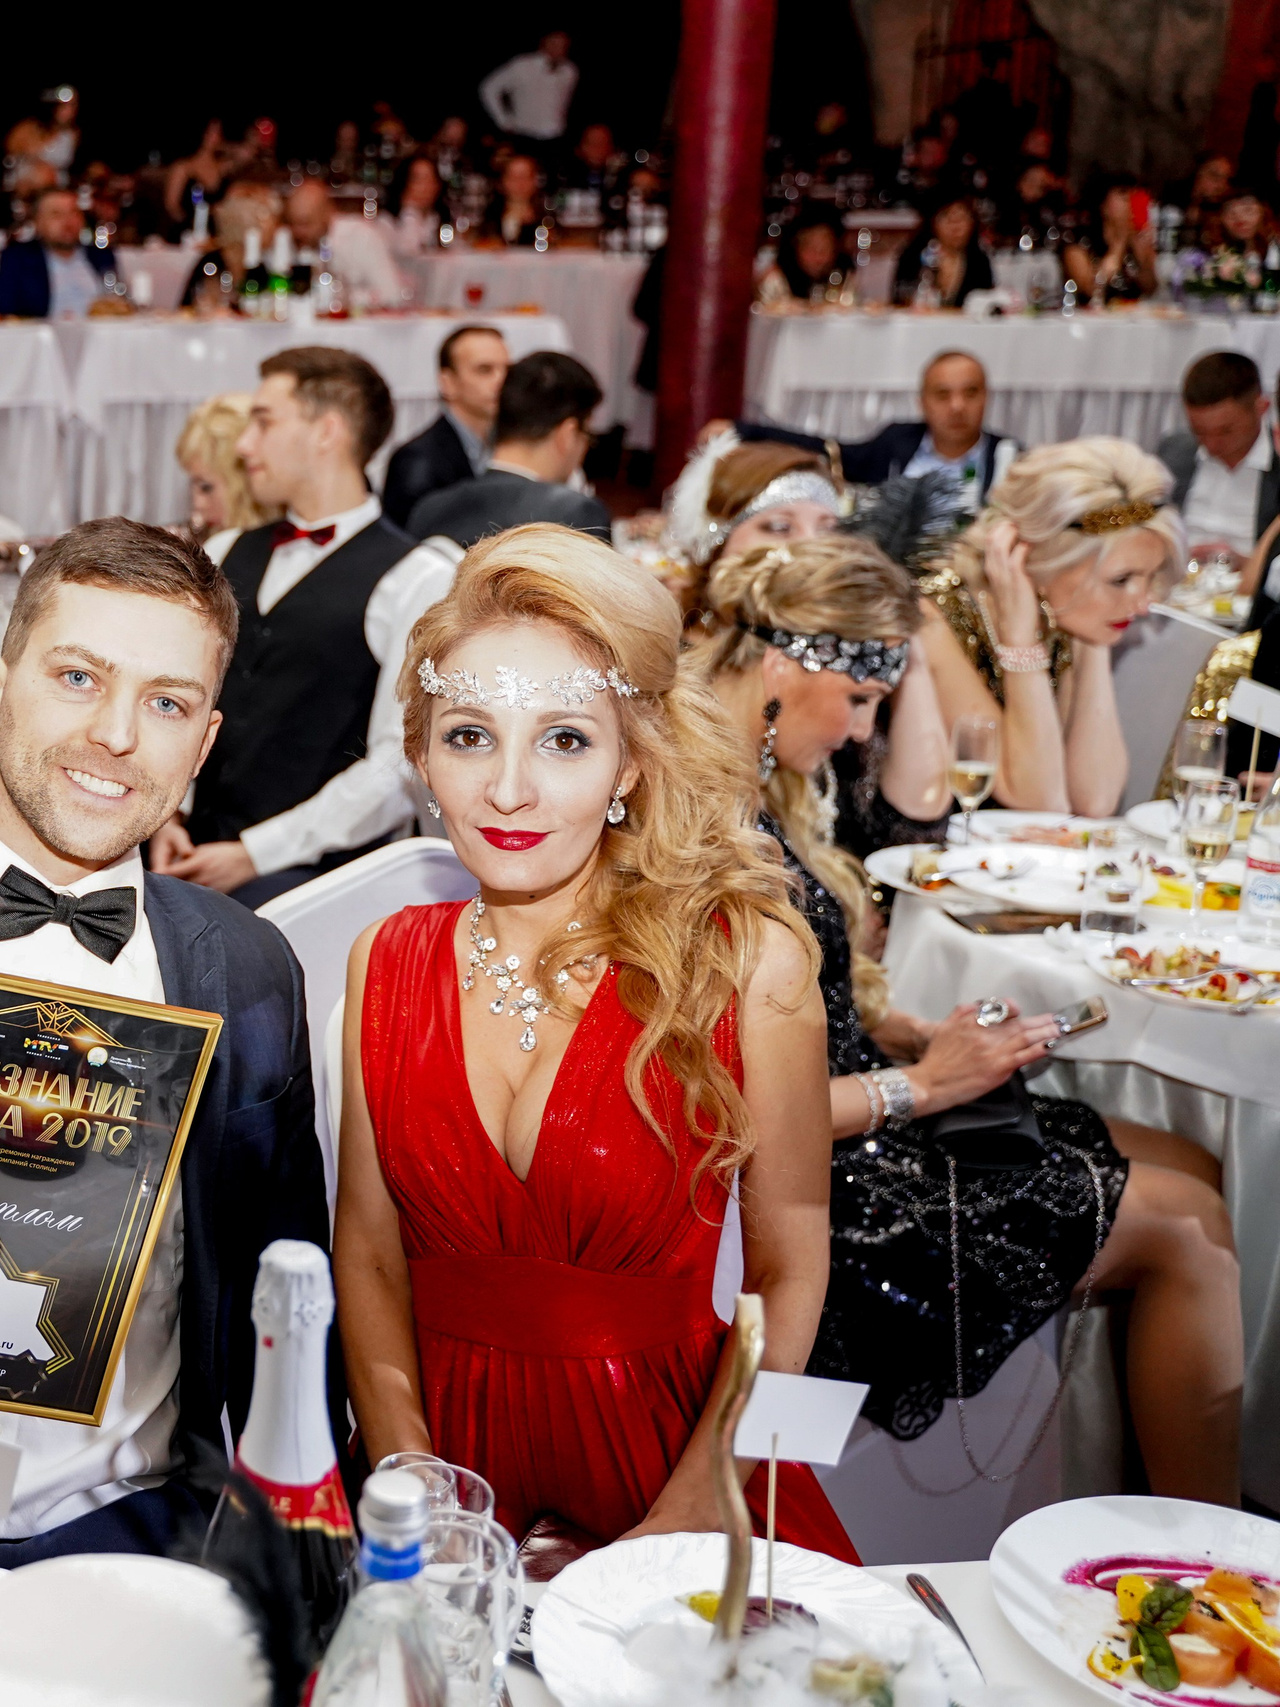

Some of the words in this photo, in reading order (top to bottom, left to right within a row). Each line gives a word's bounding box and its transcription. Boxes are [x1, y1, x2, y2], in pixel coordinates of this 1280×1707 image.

[35, 1112, 133, 1157] 2019
[30, 1153, 76, 1167] награждения
[29, 1162, 58, 1173] столицы
